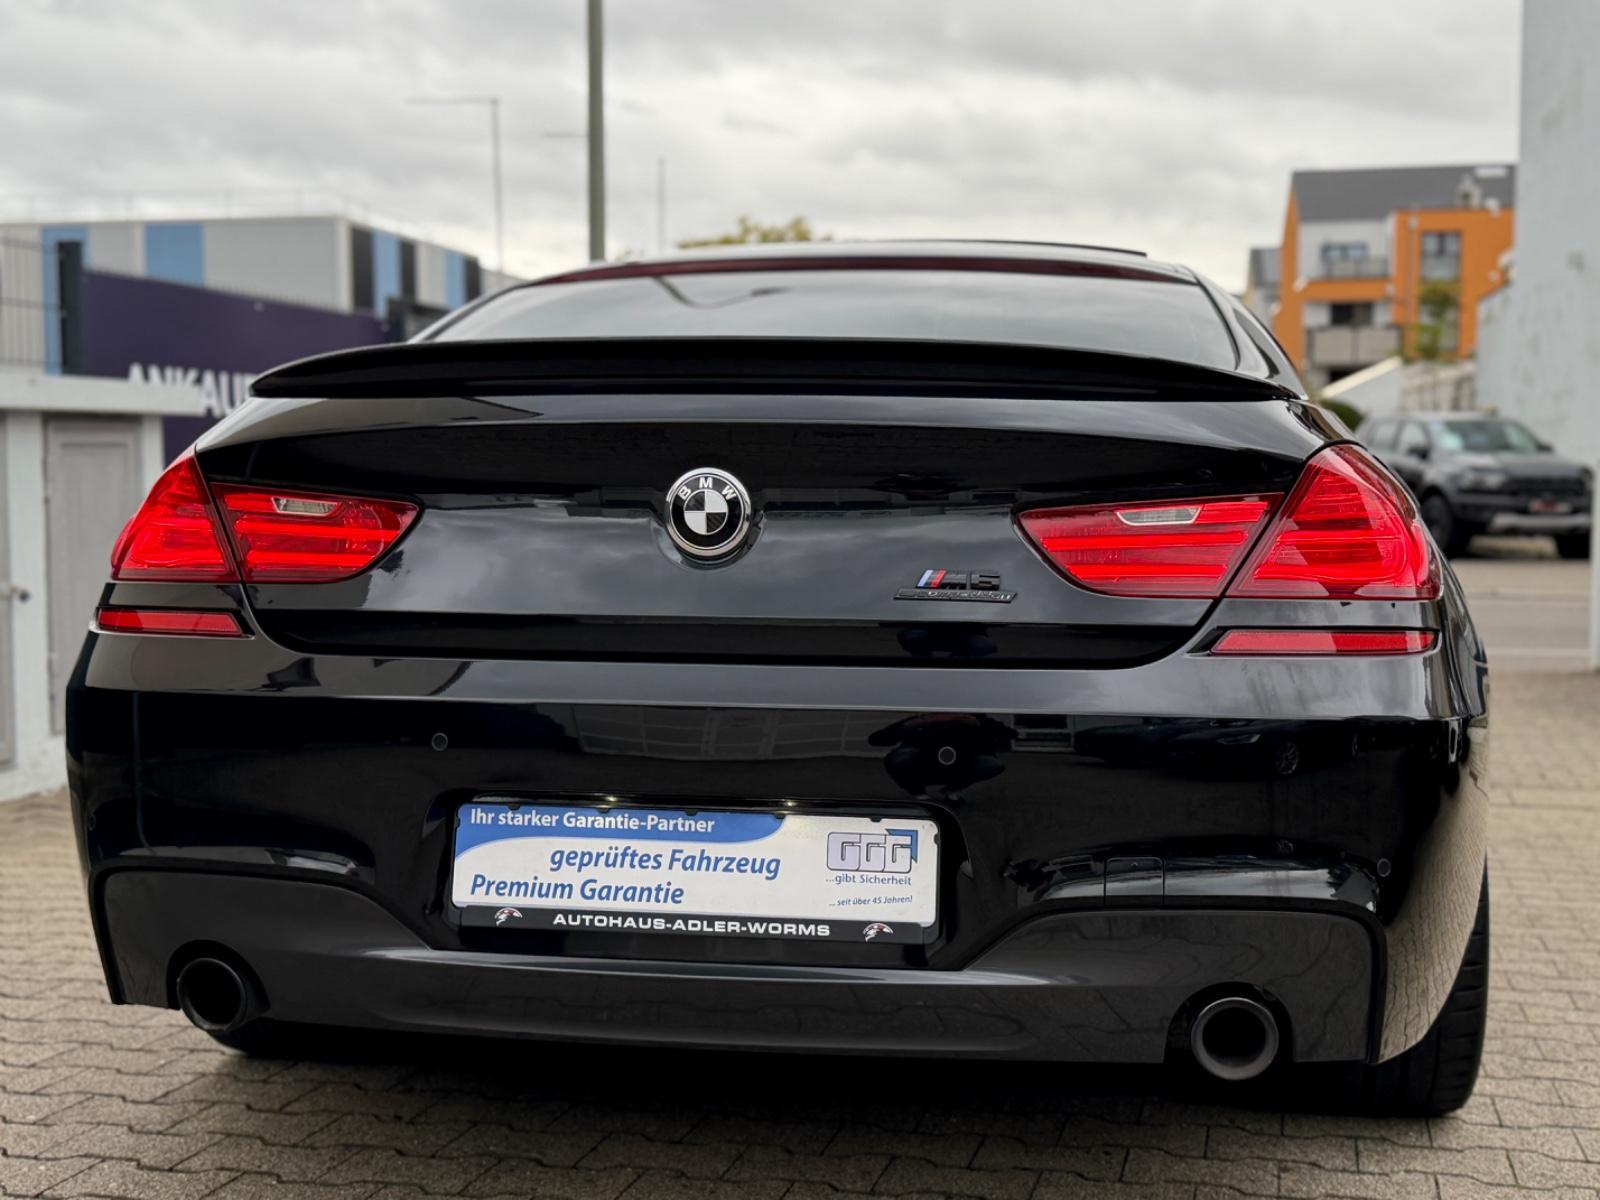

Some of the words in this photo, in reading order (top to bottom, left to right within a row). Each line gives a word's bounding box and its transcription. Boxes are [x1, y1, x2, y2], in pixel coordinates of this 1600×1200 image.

[678, 477, 737, 501] BMW
[470, 808, 495, 825] Ihr
[498, 810, 559, 827] starker
[563, 811, 715, 833] Garantie-Partner
[549, 845, 663, 873] geprüftes
[667, 848, 781, 881] Fahrzeug
[827, 831, 913, 874] GGG
[470, 873, 574, 900] Premium
[579, 877, 684, 905] Garantie
[859, 874, 912, 886] Sicherheit
[837, 897, 852, 906] seit
[852, 897, 871, 906] über
[871, 895, 882, 905] 45
[552, 913, 831, 938] AUTOHAUS-ADLER-WORMS
